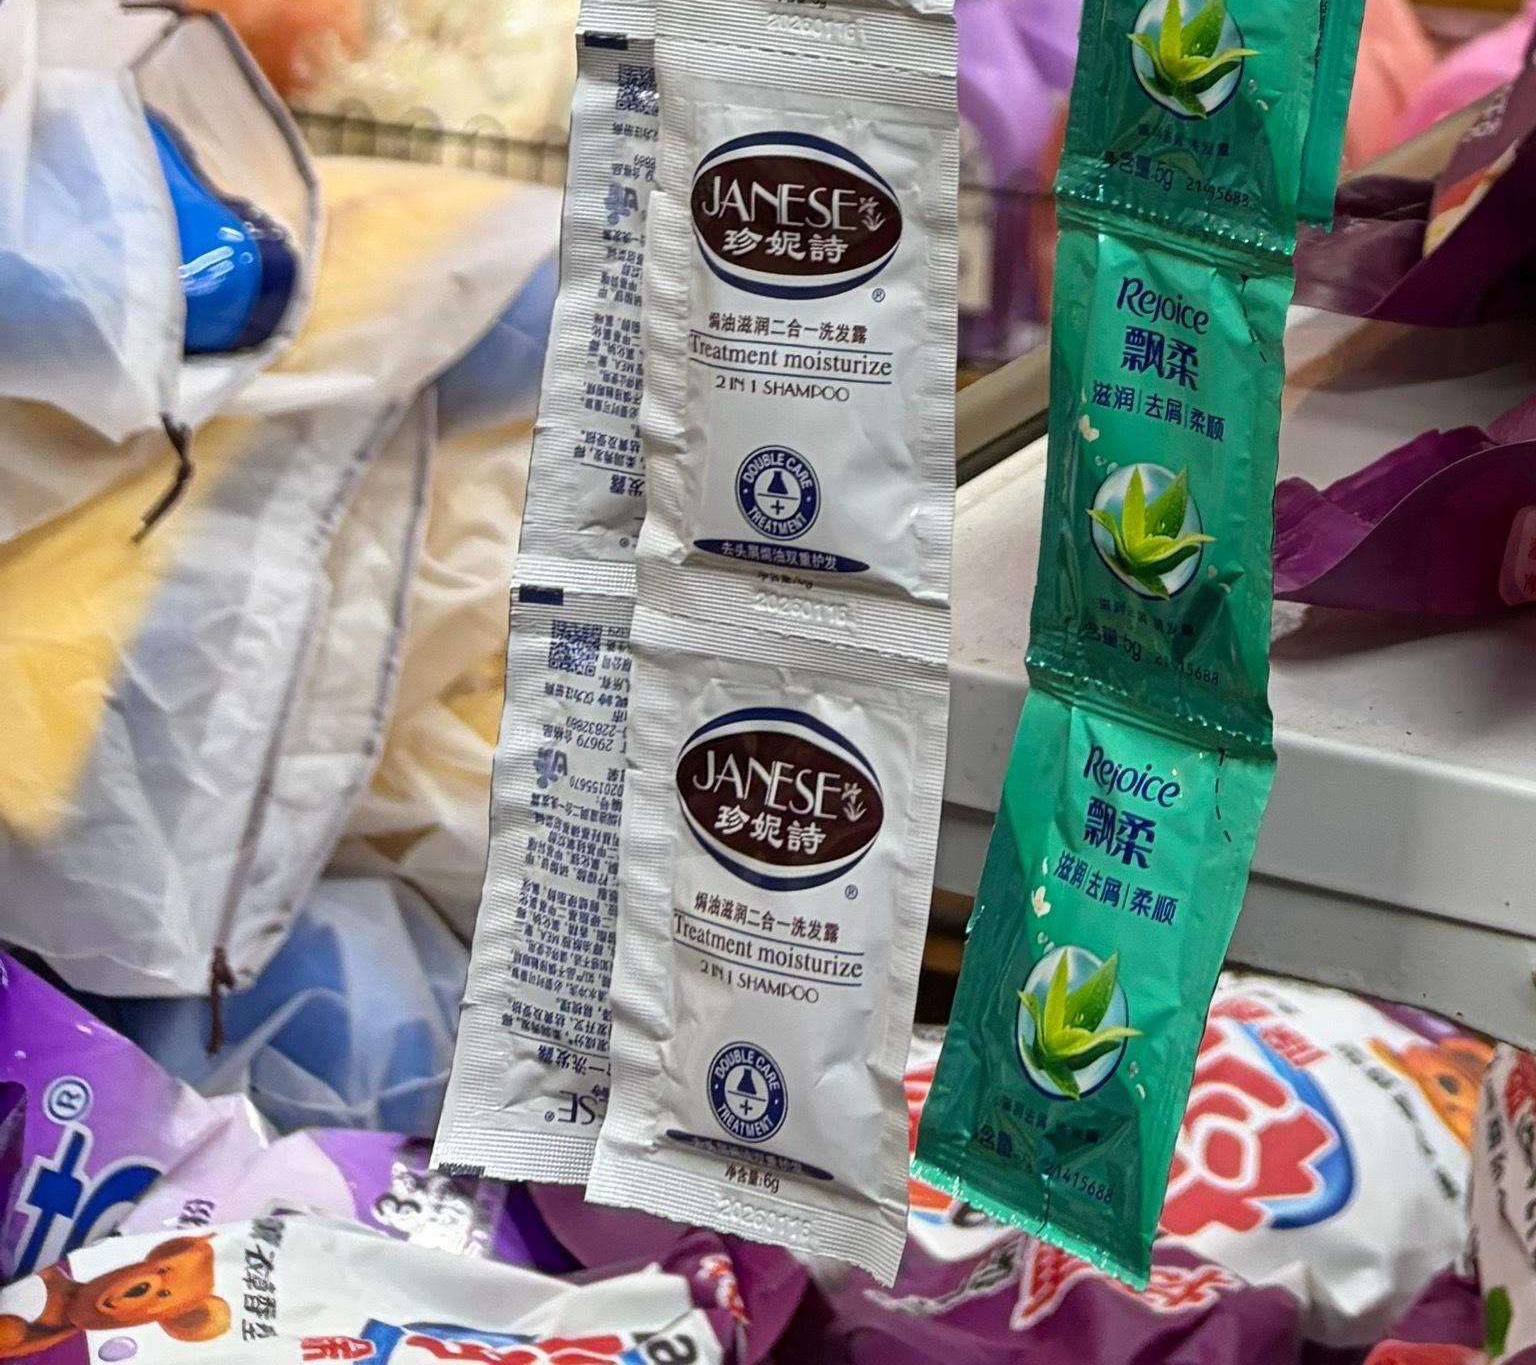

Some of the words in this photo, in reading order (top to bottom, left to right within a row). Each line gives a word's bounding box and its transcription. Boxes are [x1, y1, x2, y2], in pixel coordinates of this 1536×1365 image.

[702, 175, 859, 233] JANESE
[721, 227, 850, 265] 珍妮詩
[1116, 275, 1211, 336] Rejoice
[689, 332, 777, 366] Treatment
[783, 349, 893, 379] moisturize
[1120, 325, 1200, 393] 飘柔
[715, 374, 727, 390] 2
[729, 377, 746, 393] IN
[763, 380, 851, 404] SHAMPOO
[693, 748, 842, 821] JANESE
[1082, 742, 1182, 809] Rejoice
[713, 805, 828, 856] 珍妮詩
[1082, 795, 1159, 870] 飘柔
[673, 915, 752, 960] Treatment
[757, 938, 865, 980] moisturize
[700, 959, 710, 975] 2
[711, 962, 728, 982] IN
[737, 970, 820, 1005] SHAMPOO
